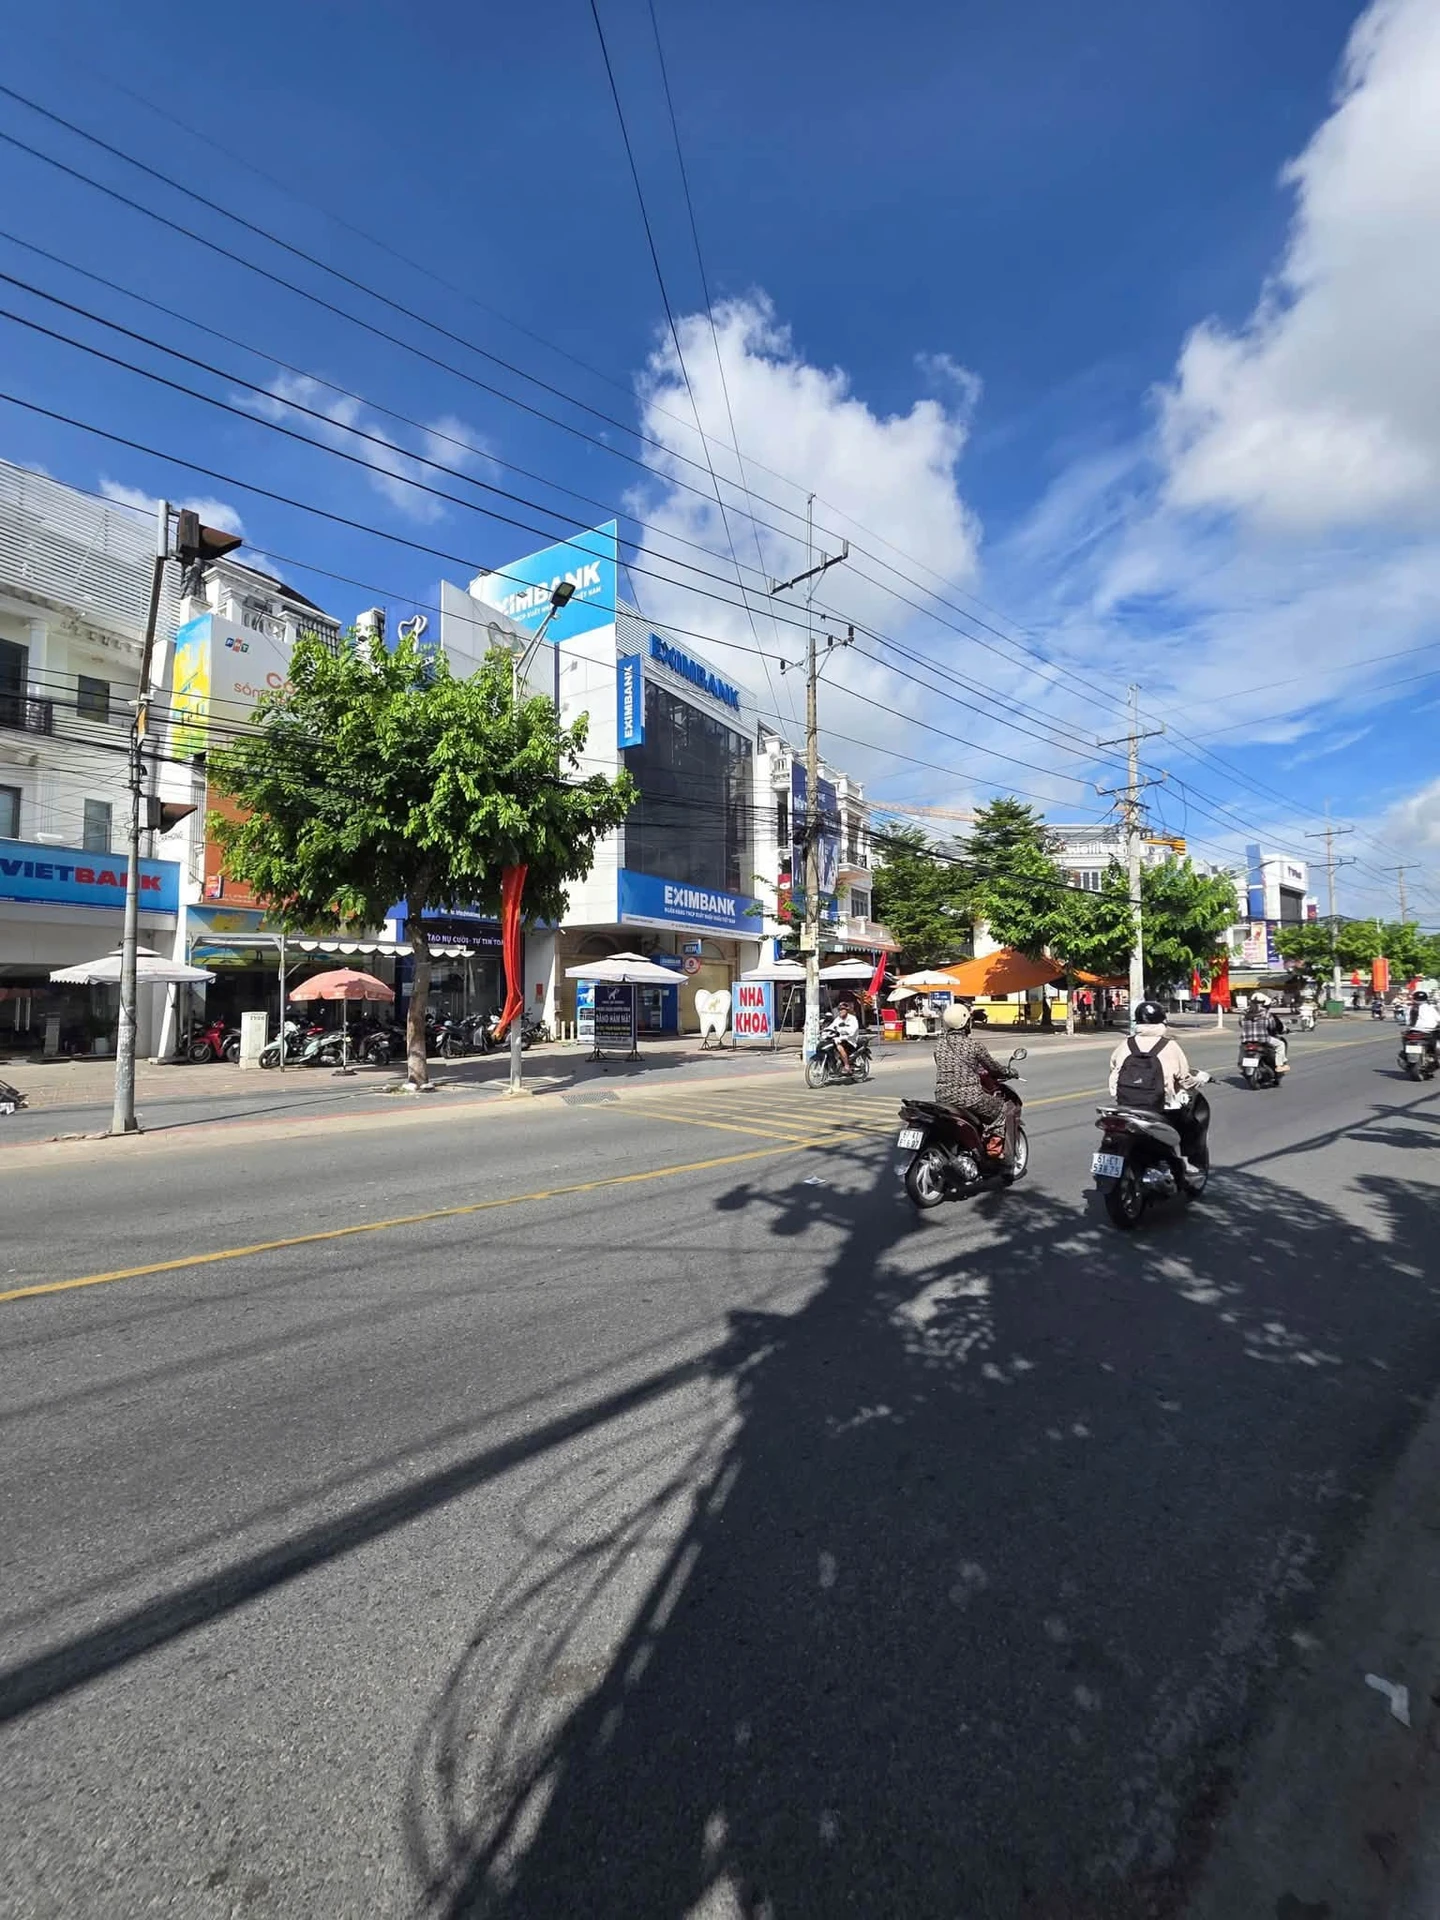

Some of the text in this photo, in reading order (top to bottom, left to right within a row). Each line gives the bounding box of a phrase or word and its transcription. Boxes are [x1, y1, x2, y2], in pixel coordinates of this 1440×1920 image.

[225, 637, 249, 653] FPT
[648, 632, 740, 712] EXIMBANK
[624, 665, 633, 738] EXIMBANK
[664, 885, 735, 916] EXIMBANK
[739, 987, 764, 1007] NHA
[735, 1012, 769, 1033] KHOA
